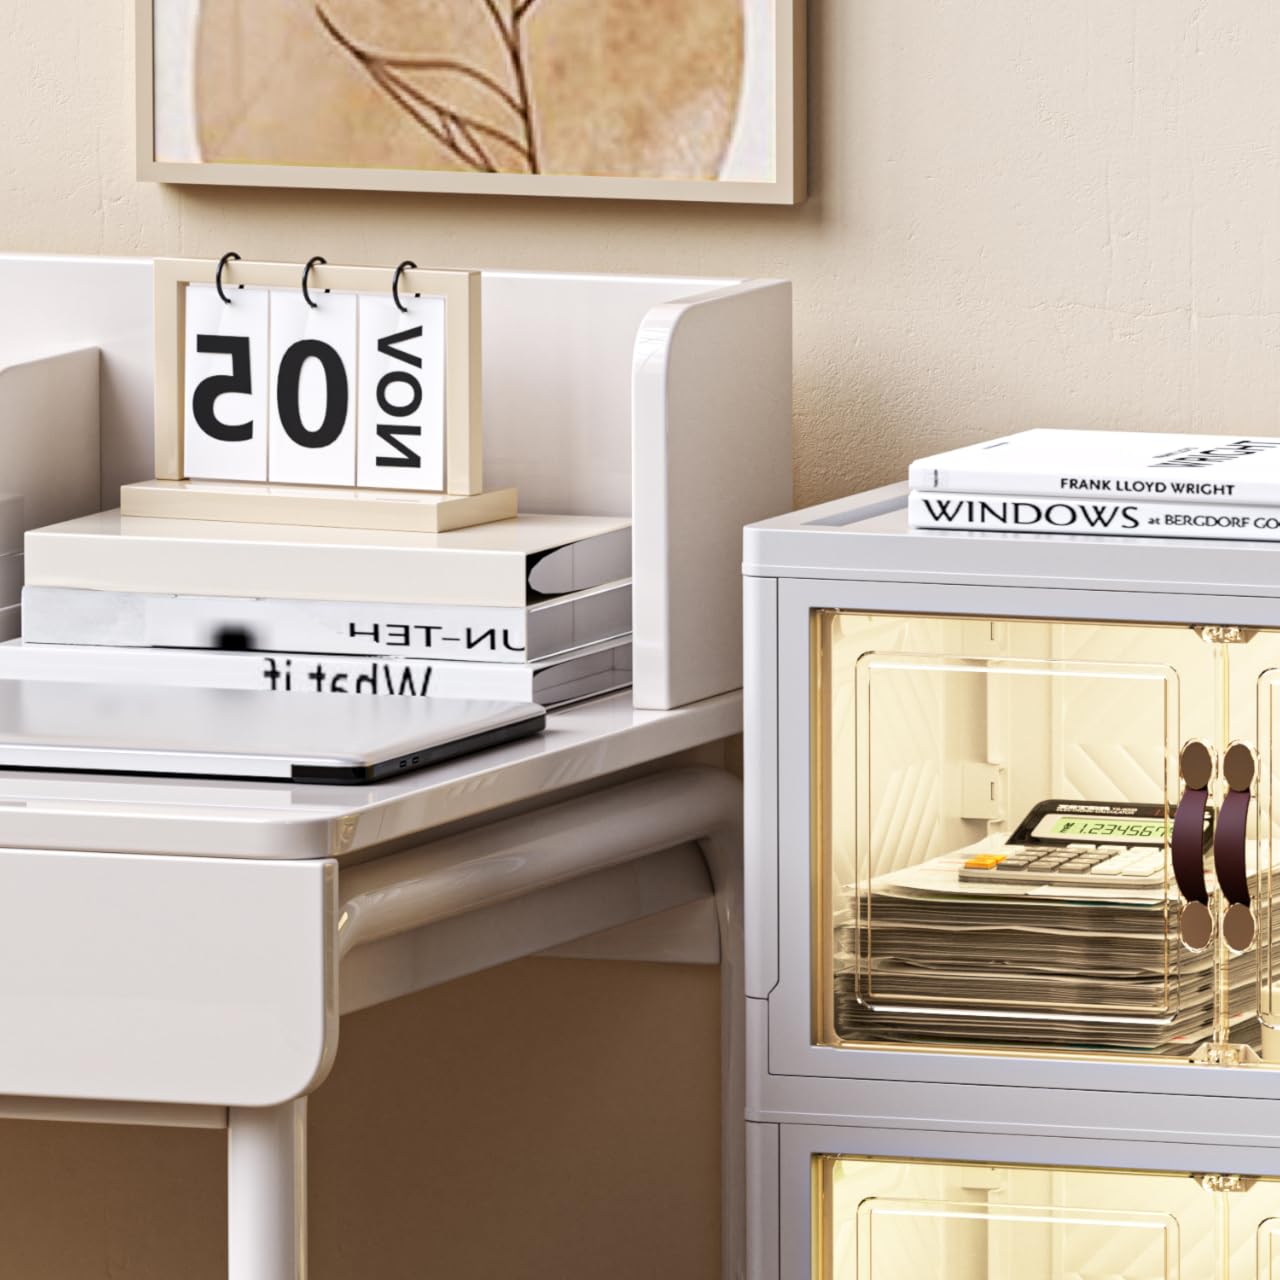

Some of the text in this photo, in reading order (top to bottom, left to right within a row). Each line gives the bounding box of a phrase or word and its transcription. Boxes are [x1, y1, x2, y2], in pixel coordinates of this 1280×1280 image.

[1060, 477, 1235, 496] FRANK LLOYD WRIGHT
[922, 499, 1140, 529] WINDOWS
[1148, 517, 1161, 525] at
[1164, 514, 1250, 528] BERGDORF
